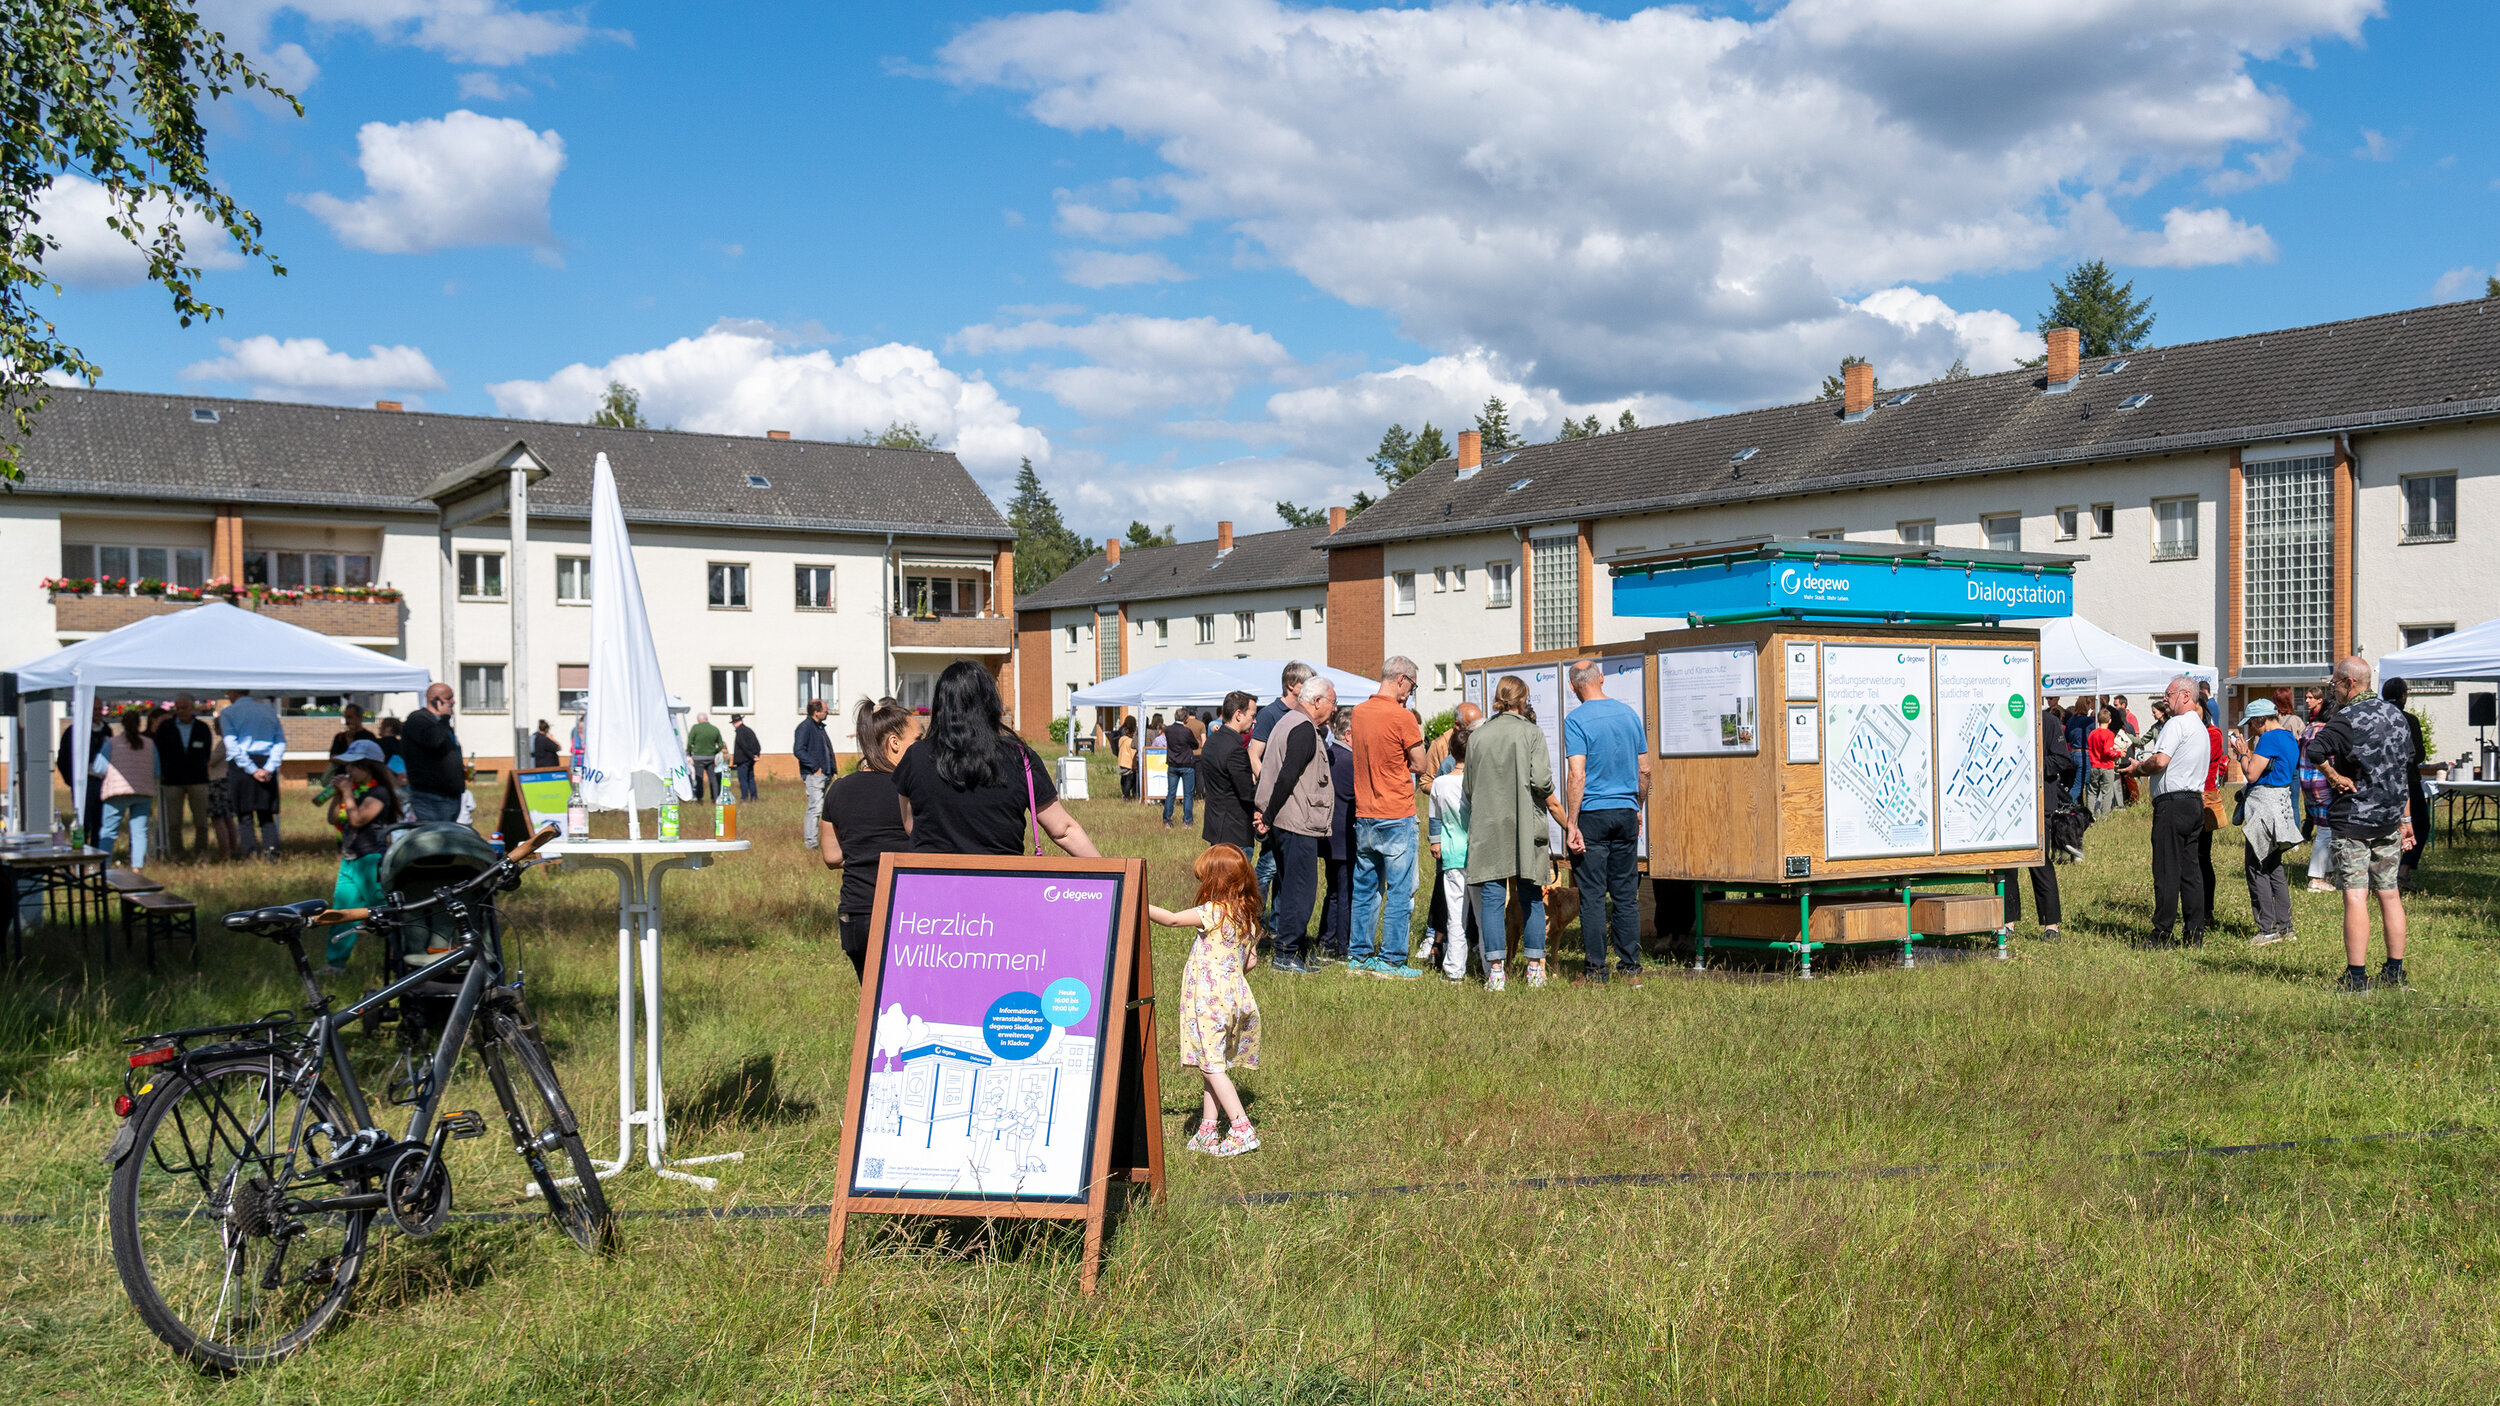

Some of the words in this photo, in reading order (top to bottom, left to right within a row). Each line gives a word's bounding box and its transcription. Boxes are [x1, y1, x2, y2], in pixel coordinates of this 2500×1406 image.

[1803, 573, 1849, 593] degewo
[1967, 580, 2066, 607] Dialogstation
[1906, 655, 1925, 663] degewo
[2011, 656, 2029, 664] degewo
[1828, 674, 1906, 687] Siedlungserweiterung
[1939, 675, 2011, 687] Siedlungserweiterung
[2055, 675, 2087, 687] degewo
[1828, 688, 1864, 699] nördlicher
[1867, 688, 1880, 698] Teil
[1939, 688, 1971, 698] südlicher
[1973, 688, 1984, 698] Teil
[1062, 888, 1103, 901] degewo
[898, 911, 994, 937] Herzlich
[894, 943, 1047, 971] Willkommen!
[989, 1023, 1013, 1031] degewo
[1014, 1024, 1045, 1032] Siedlungs-
[998, 1032, 1034, 1040] erweiterung
